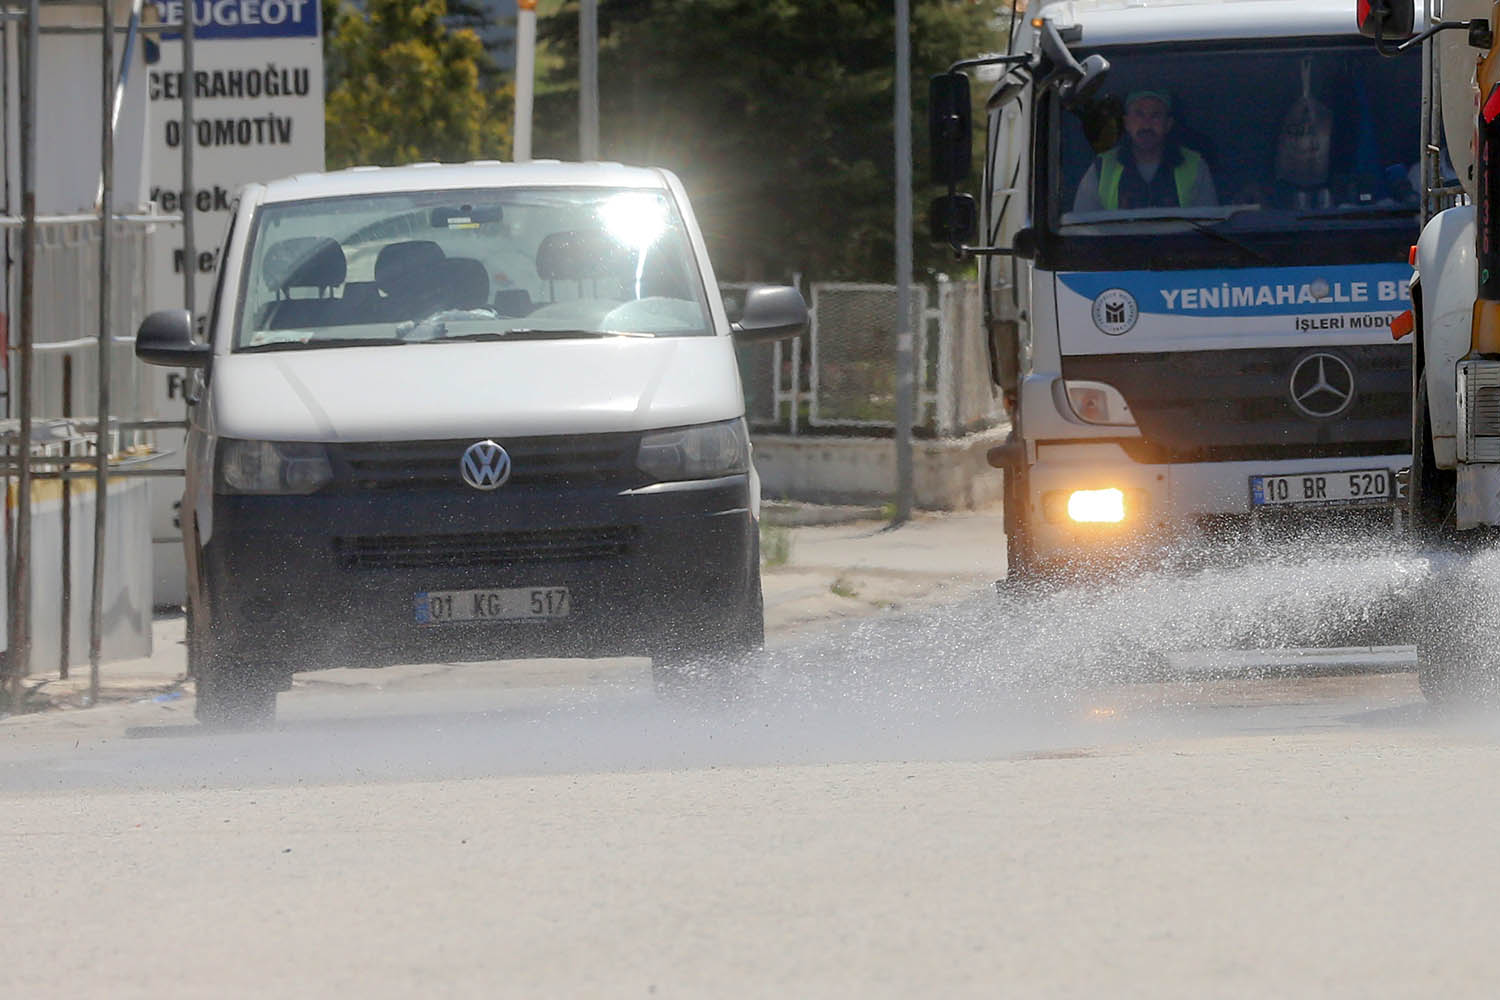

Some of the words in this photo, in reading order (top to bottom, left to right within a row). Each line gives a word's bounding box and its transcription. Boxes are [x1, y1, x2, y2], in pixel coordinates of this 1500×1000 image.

[150, 63, 310, 100] CERAHOĞLU
[165, 113, 293, 146] OOMOTİV
[1160, 282, 1369, 310] YENİMAHALE
[1295, 315, 1345, 333] İŞLERİ
[1267, 479, 1289, 501] 10
[1303, 477, 1327, 499] BR
[1349, 474, 1386, 496] 520
[431, 596, 454, 619] 01
[473, 593, 501, 617] KG
[531, 590, 567, 614] 517
